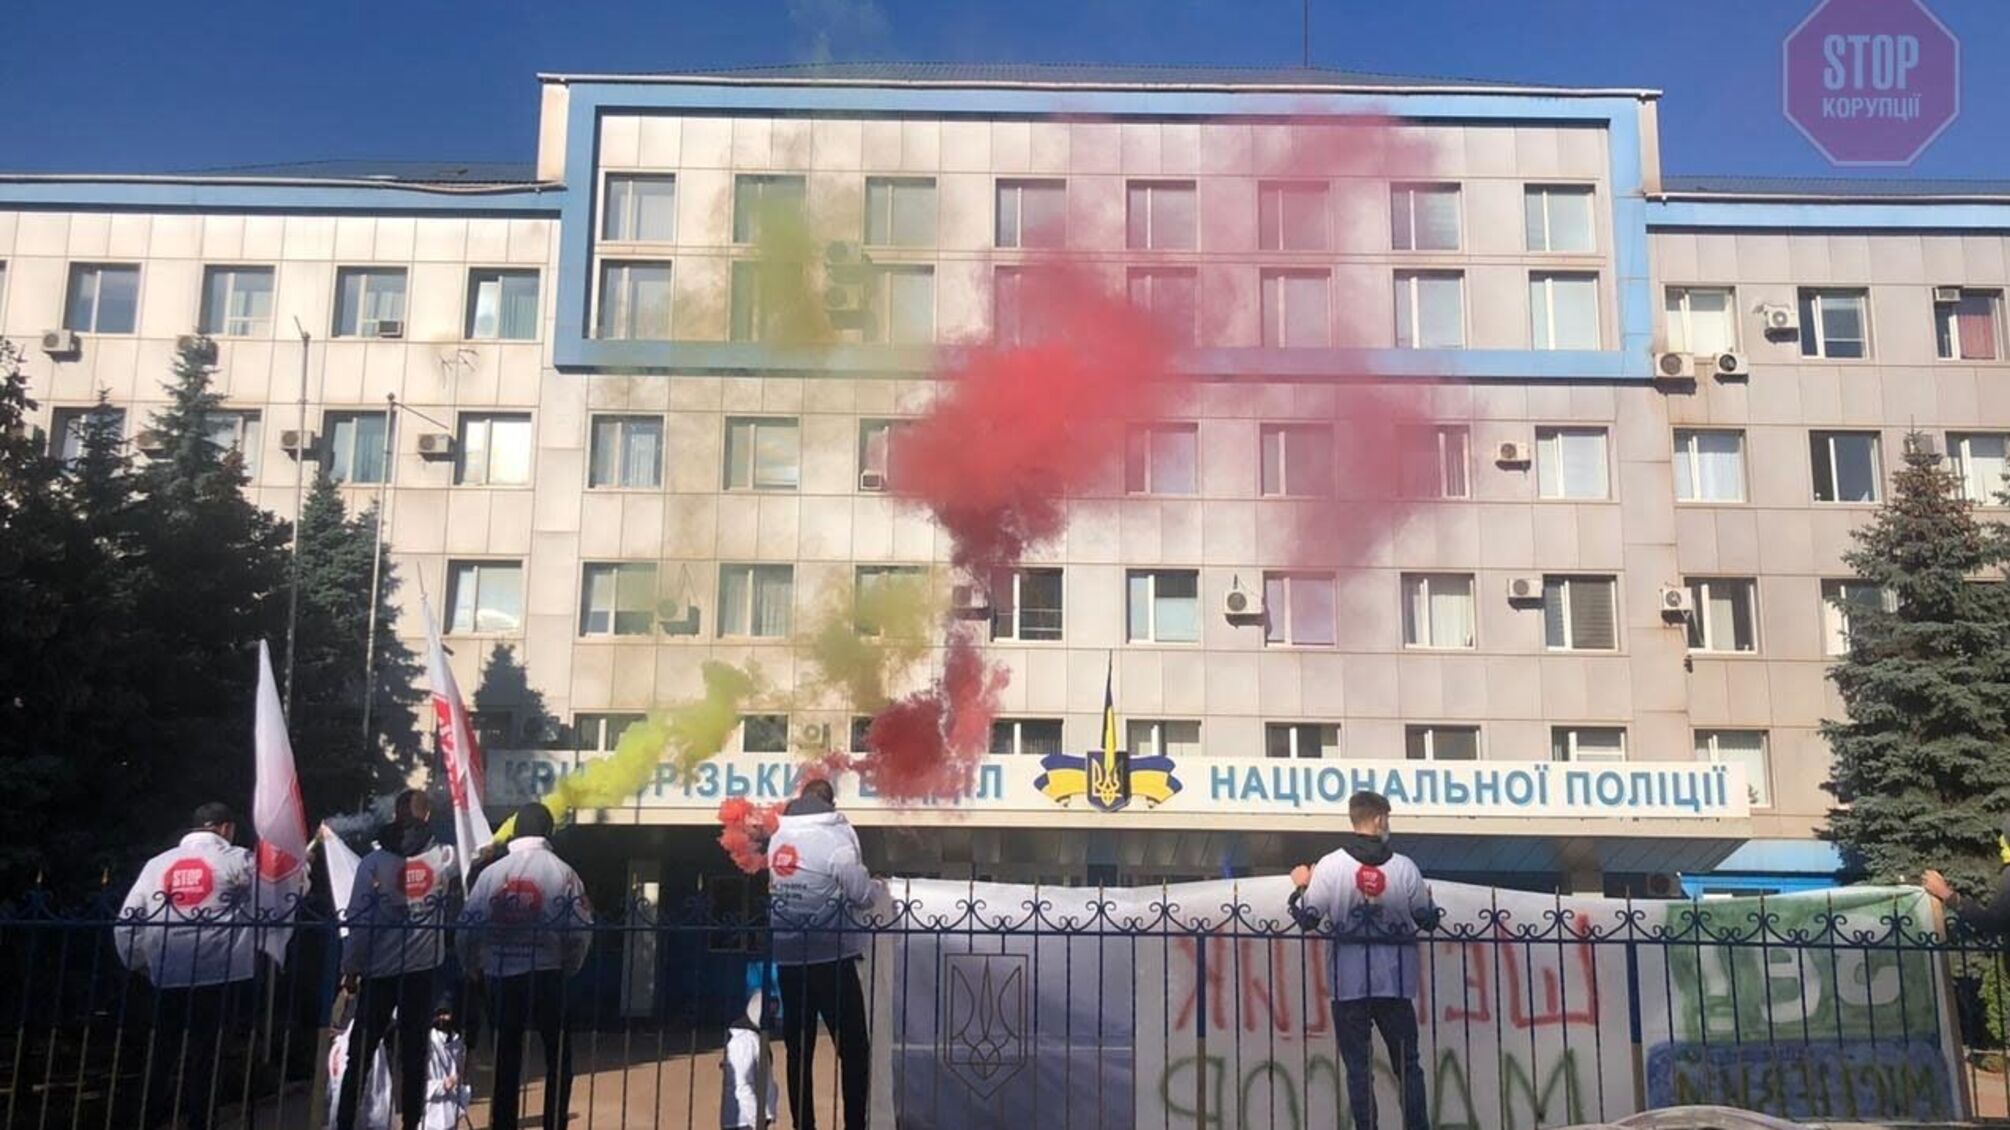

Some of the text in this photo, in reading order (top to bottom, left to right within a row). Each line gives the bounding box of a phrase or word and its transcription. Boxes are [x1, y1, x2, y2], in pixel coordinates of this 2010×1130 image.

[1210, 763, 1550, 808] НАЦІОНАЛЬНОЇ
[1565, 765, 1728, 813] ПОЛІЦІЇ
[172, 868, 204, 889] STOP
